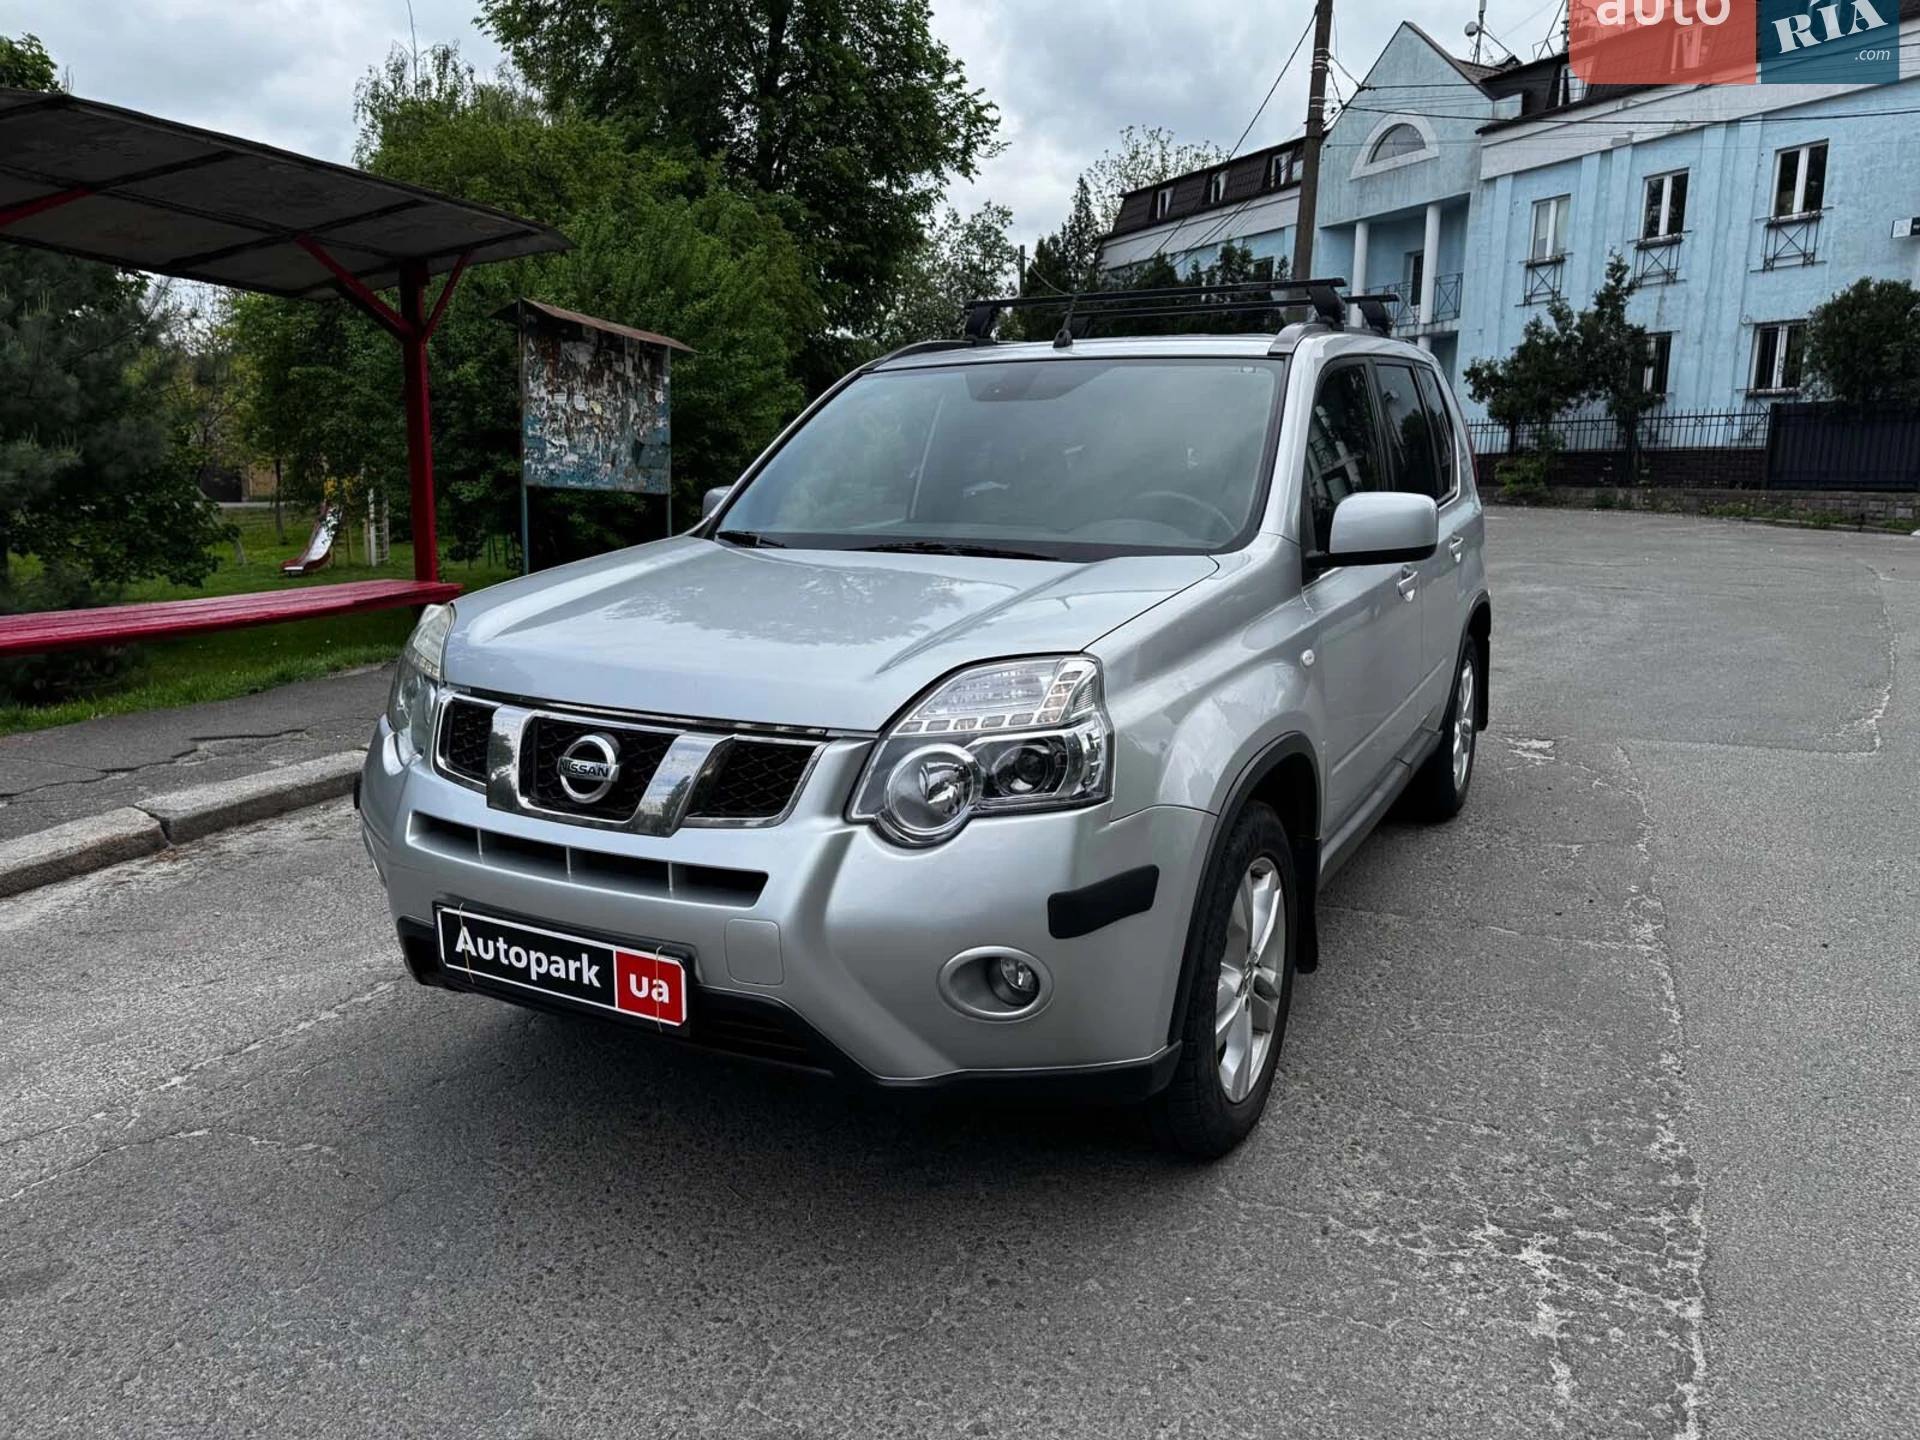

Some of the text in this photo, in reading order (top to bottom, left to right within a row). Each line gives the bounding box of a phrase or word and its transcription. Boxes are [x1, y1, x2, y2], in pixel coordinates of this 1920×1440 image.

[561, 761, 609, 778] NISSAN
[455, 925, 671, 1004] Autopark ua
